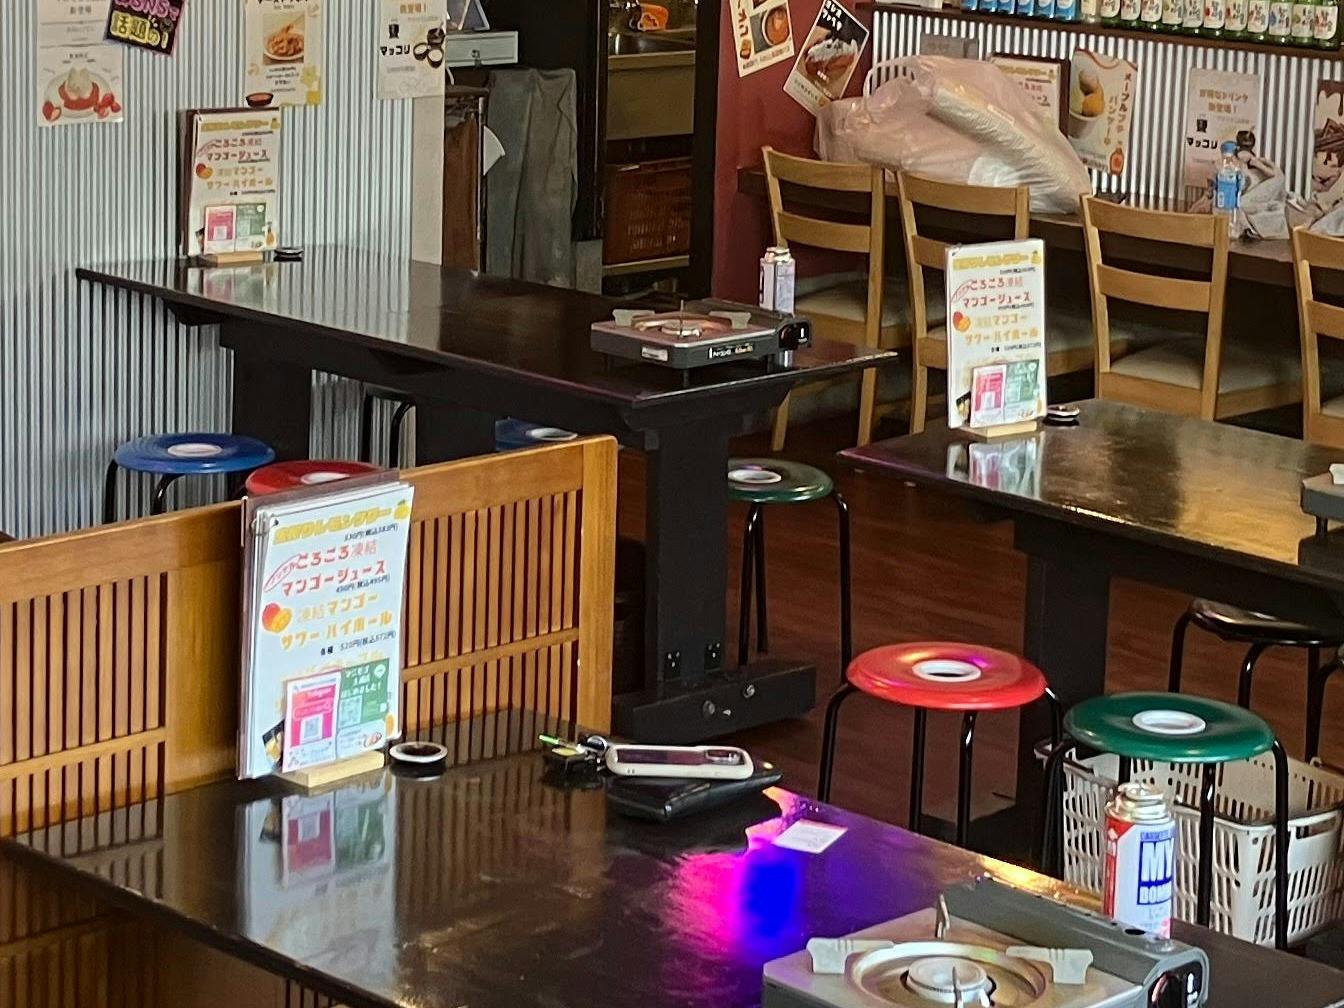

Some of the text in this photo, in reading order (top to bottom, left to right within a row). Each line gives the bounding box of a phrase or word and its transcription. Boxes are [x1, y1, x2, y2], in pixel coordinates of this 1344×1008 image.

[379, 44, 411, 57] マッコリ
[1186, 136, 1218, 150] マッコリ
[281, 559, 386, 598] マンゴージュース
